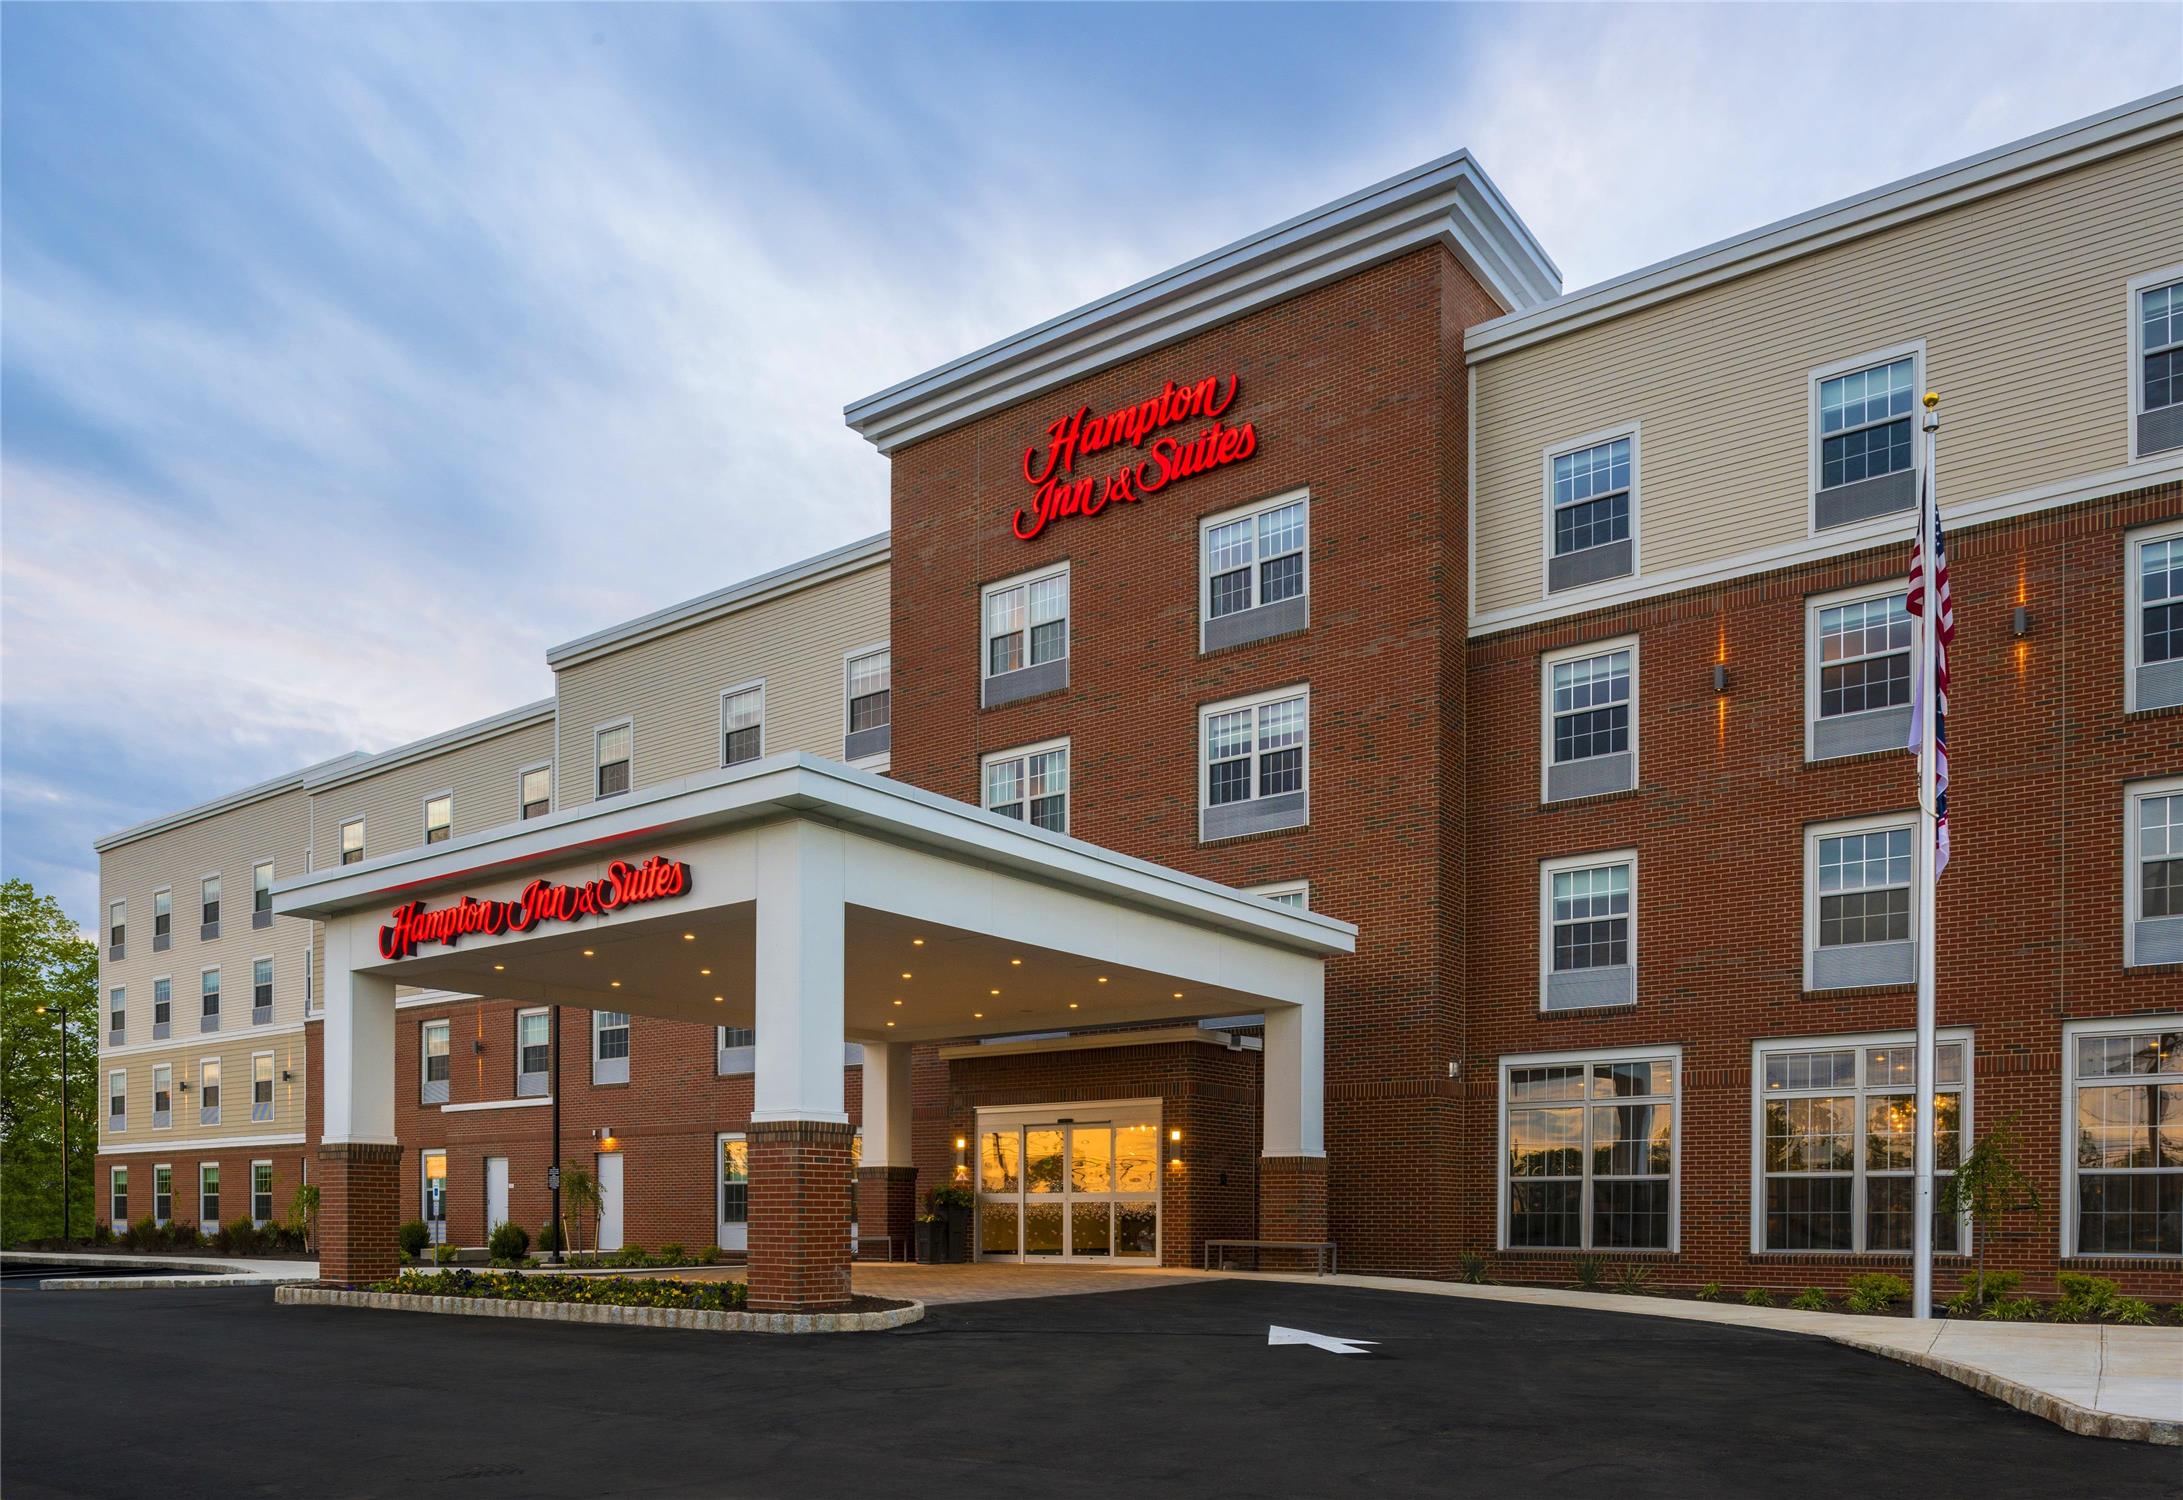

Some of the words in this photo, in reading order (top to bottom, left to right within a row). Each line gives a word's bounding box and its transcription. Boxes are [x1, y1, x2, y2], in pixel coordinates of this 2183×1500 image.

[1012, 475, 1112, 540] Inn
[1110, 466, 1138, 502] &
[1135, 422, 1257, 492] Suites
[1023, 373, 1237, 486] Hampton
[379, 896, 503, 959] Hampton
[507, 880, 580, 931] Inn
[579, 881, 602, 915] &
[597, 856, 686, 909] Suites
